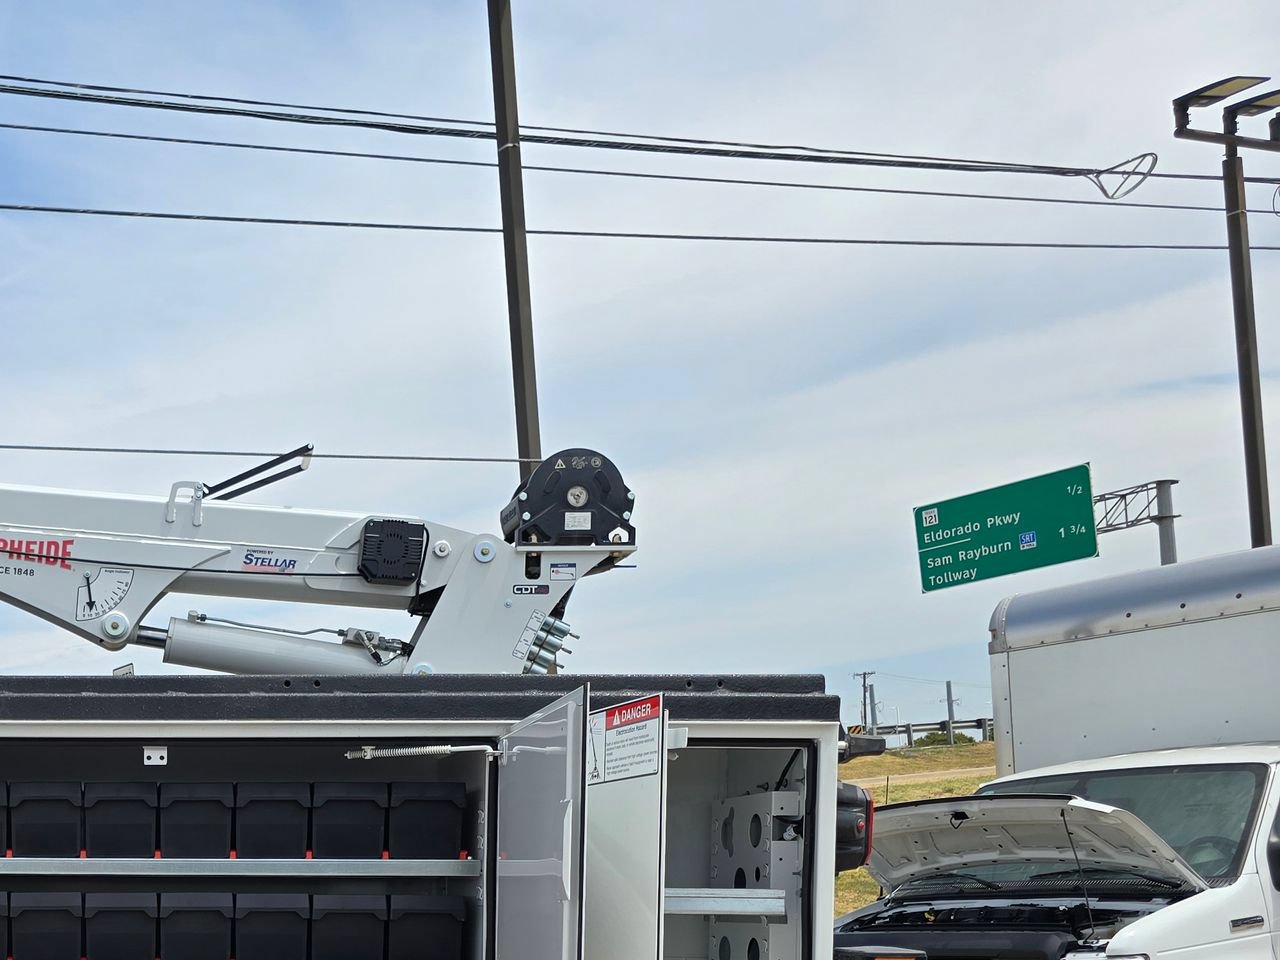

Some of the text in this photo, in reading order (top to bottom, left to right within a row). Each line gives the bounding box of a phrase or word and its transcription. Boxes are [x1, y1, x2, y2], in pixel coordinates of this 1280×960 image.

[1066, 484, 1083, 495] 1/2
[923, 511, 1021, 544] Eldorado Pkwy
[924, 514, 937, 526] 121
[1021, 533, 1034, 544] SRT
[1058, 524, 1087, 539] 1 3/4
[243, 553, 297, 569] STELLAR
[927, 541, 1012, 569] Sam Rayburn
[13, 567, 35, 577] 1848
[928, 568, 978, 586] Tollway
[621, 703, 652, 722] DANGER
